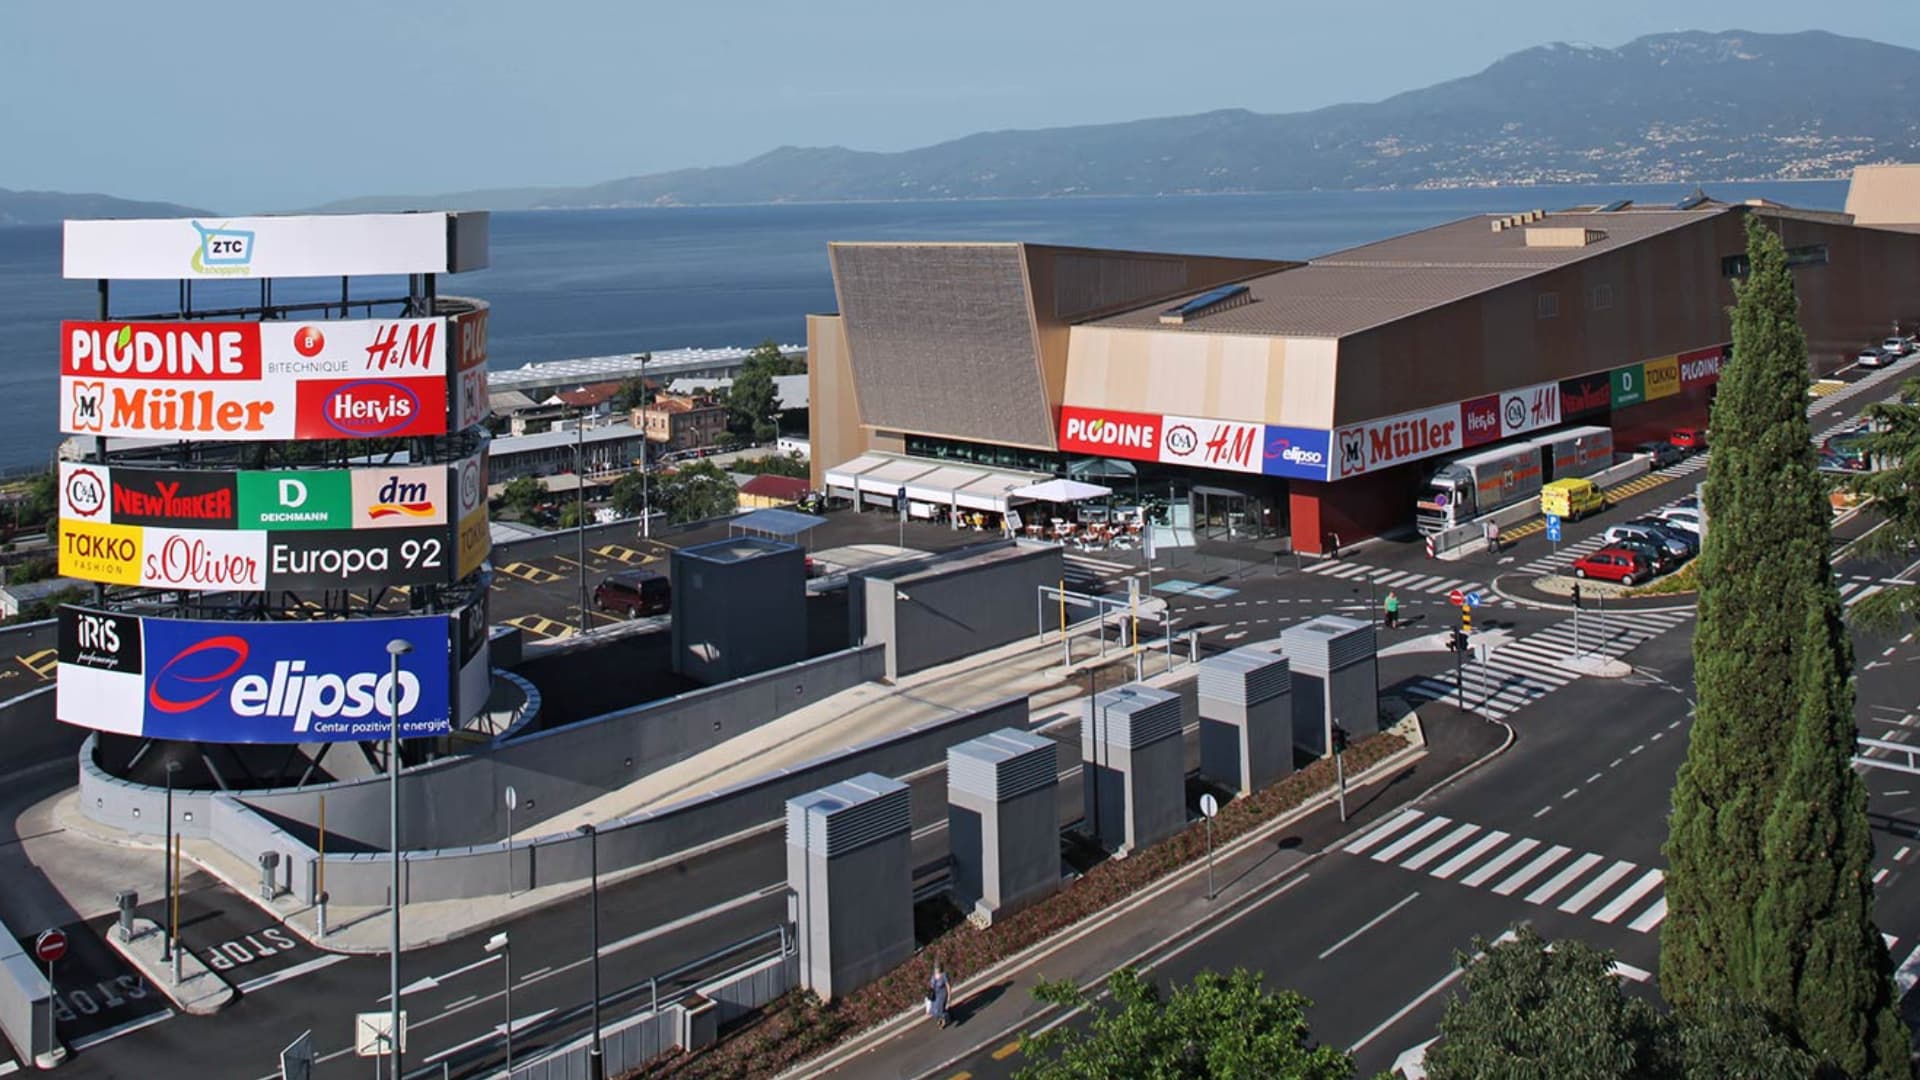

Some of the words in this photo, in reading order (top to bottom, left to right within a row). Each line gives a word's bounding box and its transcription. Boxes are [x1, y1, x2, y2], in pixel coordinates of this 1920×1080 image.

[213, 240, 242, 253] ZTC
[72, 328, 243, 375] PLODINE
[365, 324, 437, 371] H&M
[268, 360, 348, 373] BITECHNIQUE
[1681, 357, 1719, 382] PLODINE
[79, 396, 95, 418] M
[110, 387, 275, 432] Müller
[335, 394, 411, 423] Hervis
[1467, 406, 1496, 433] Hervis
[1531, 387, 1557, 426] H&M
[1067, 418, 1154, 448] PLODINE
[1205, 424, 1257, 467] H&M
[1370, 418, 1456, 465] Müller
[1283, 447, 1322, 464] elipso
[73, 480, 99, 505] C&A
[279, 480, 307, 507] D
[379, 476, 427, 503] dm
[260, 512, 328, 522] DEICHMANN
[1549, 516, 1557, 525] P
[66, 533, 135, 562] TAKKO
[145, 534, 258, 585] s.Oliver
[273, 544, 388, 577] Europa
[401, 539, 441, 568] 92
[74, 561, 123, 575] FASHION
[229, 660, 420, 731] elipso
[314, 721, 349, 732] Centar
[209, 928, 297, 970] STOP
[53, 975, 147, 1021] STOP
